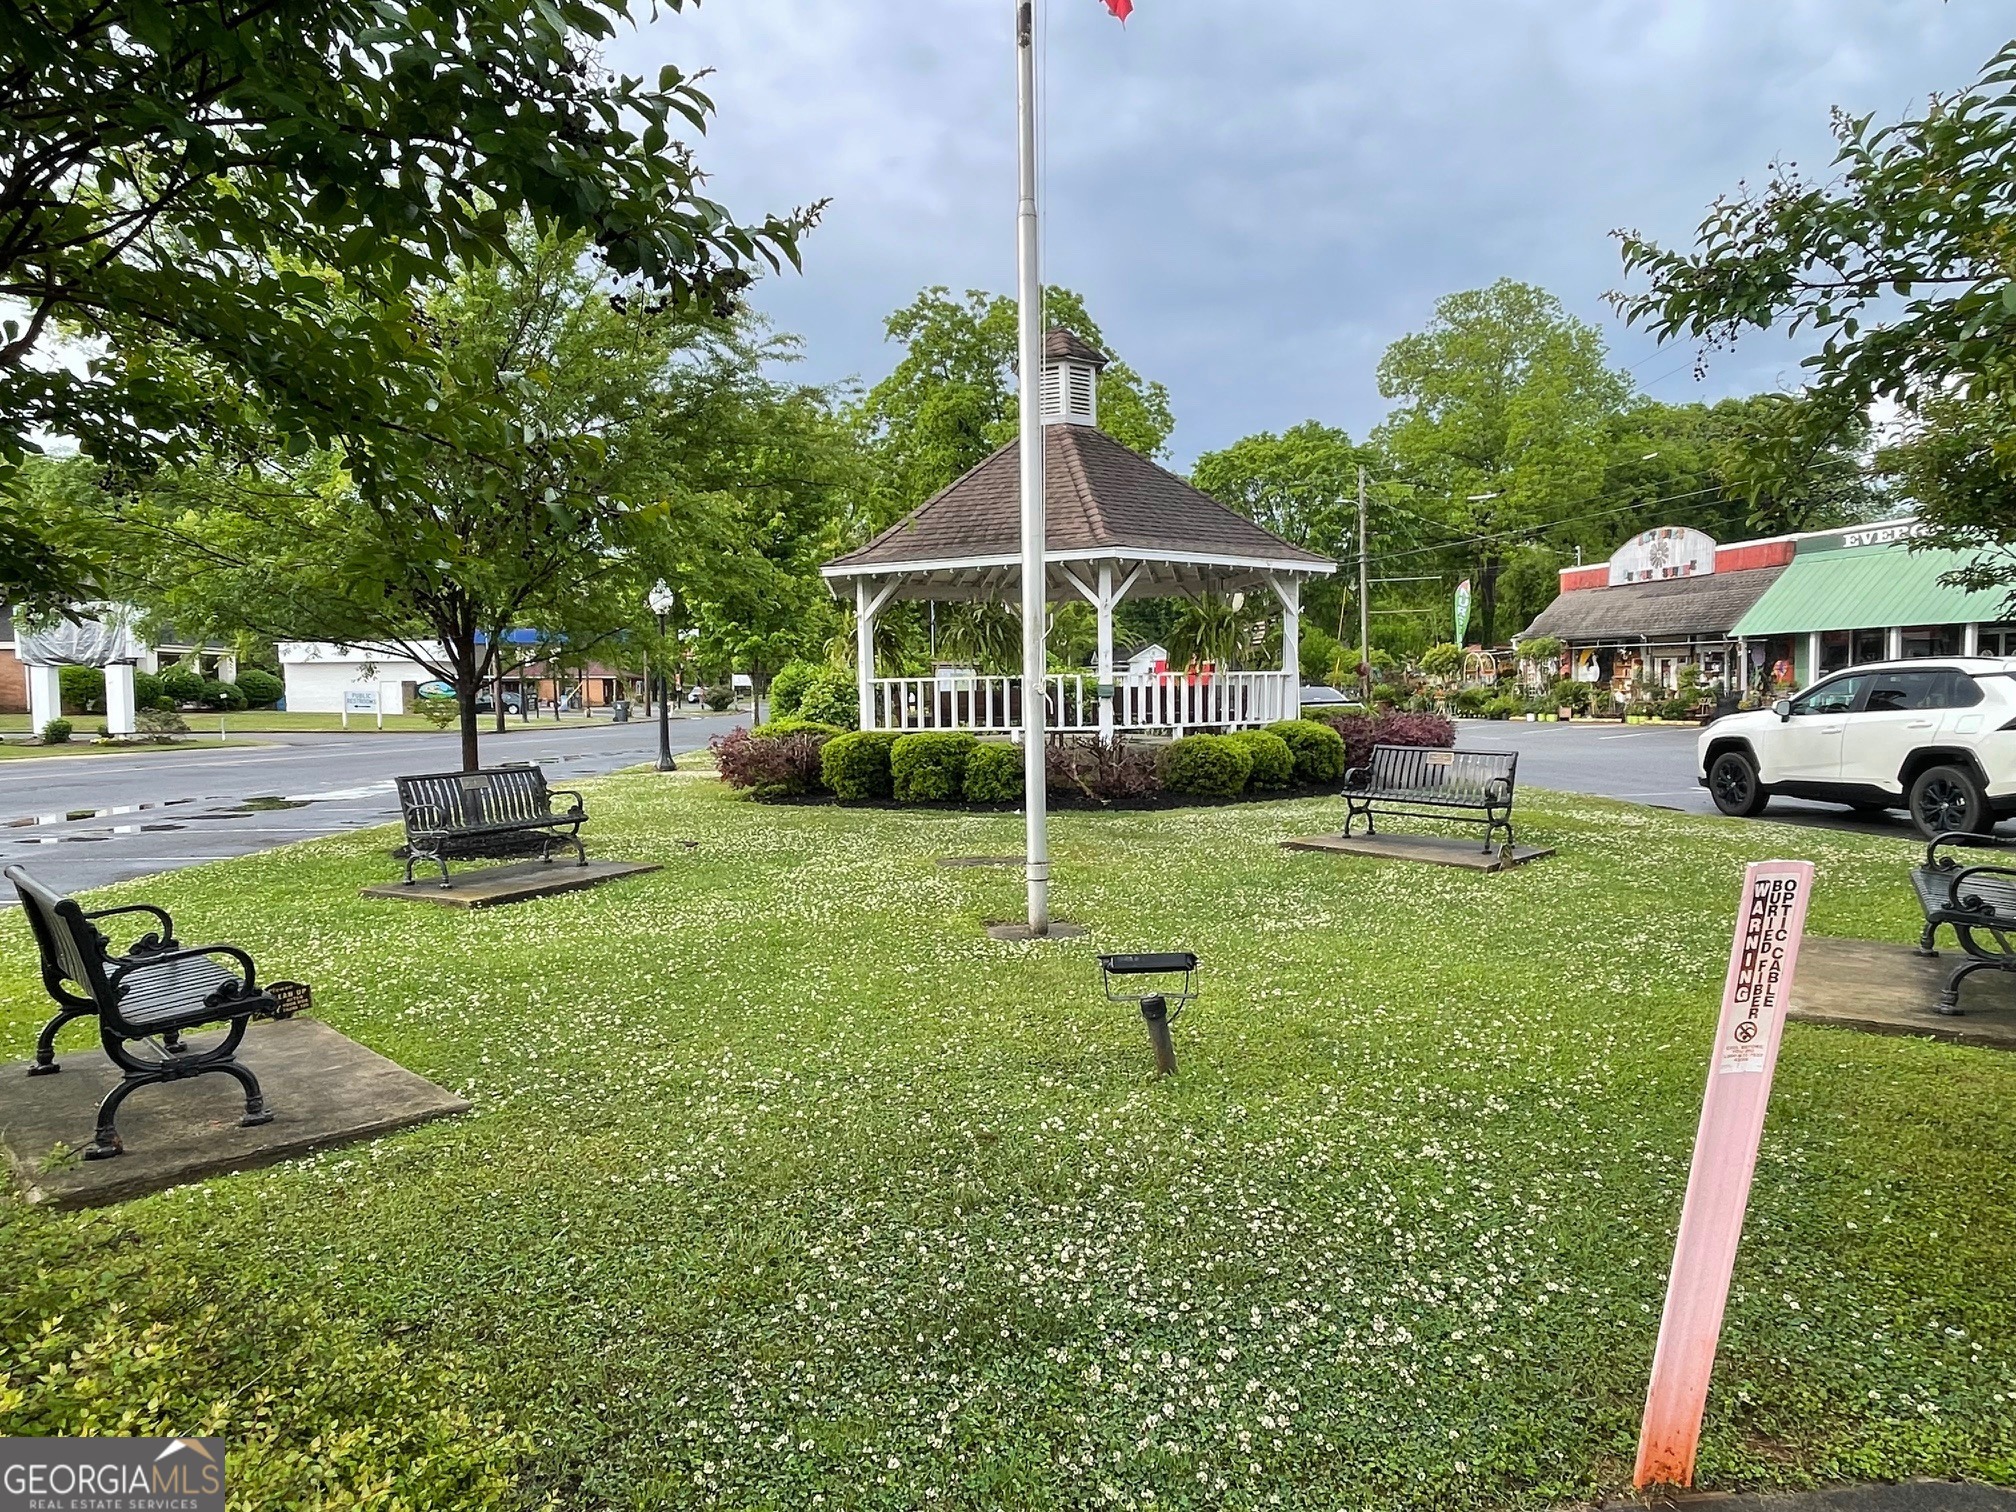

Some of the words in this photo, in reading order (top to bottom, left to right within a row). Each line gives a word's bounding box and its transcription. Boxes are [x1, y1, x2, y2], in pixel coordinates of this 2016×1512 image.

[1736, 881, 1770, 1003] WARNING
[1761, 879, 1784, 954] BURIED
[1775, 880, 1797, 942] OPTIC
[1748, 960, 1768, 1020] FIBER
[1763, 947, 1783, 1008] CABLE
